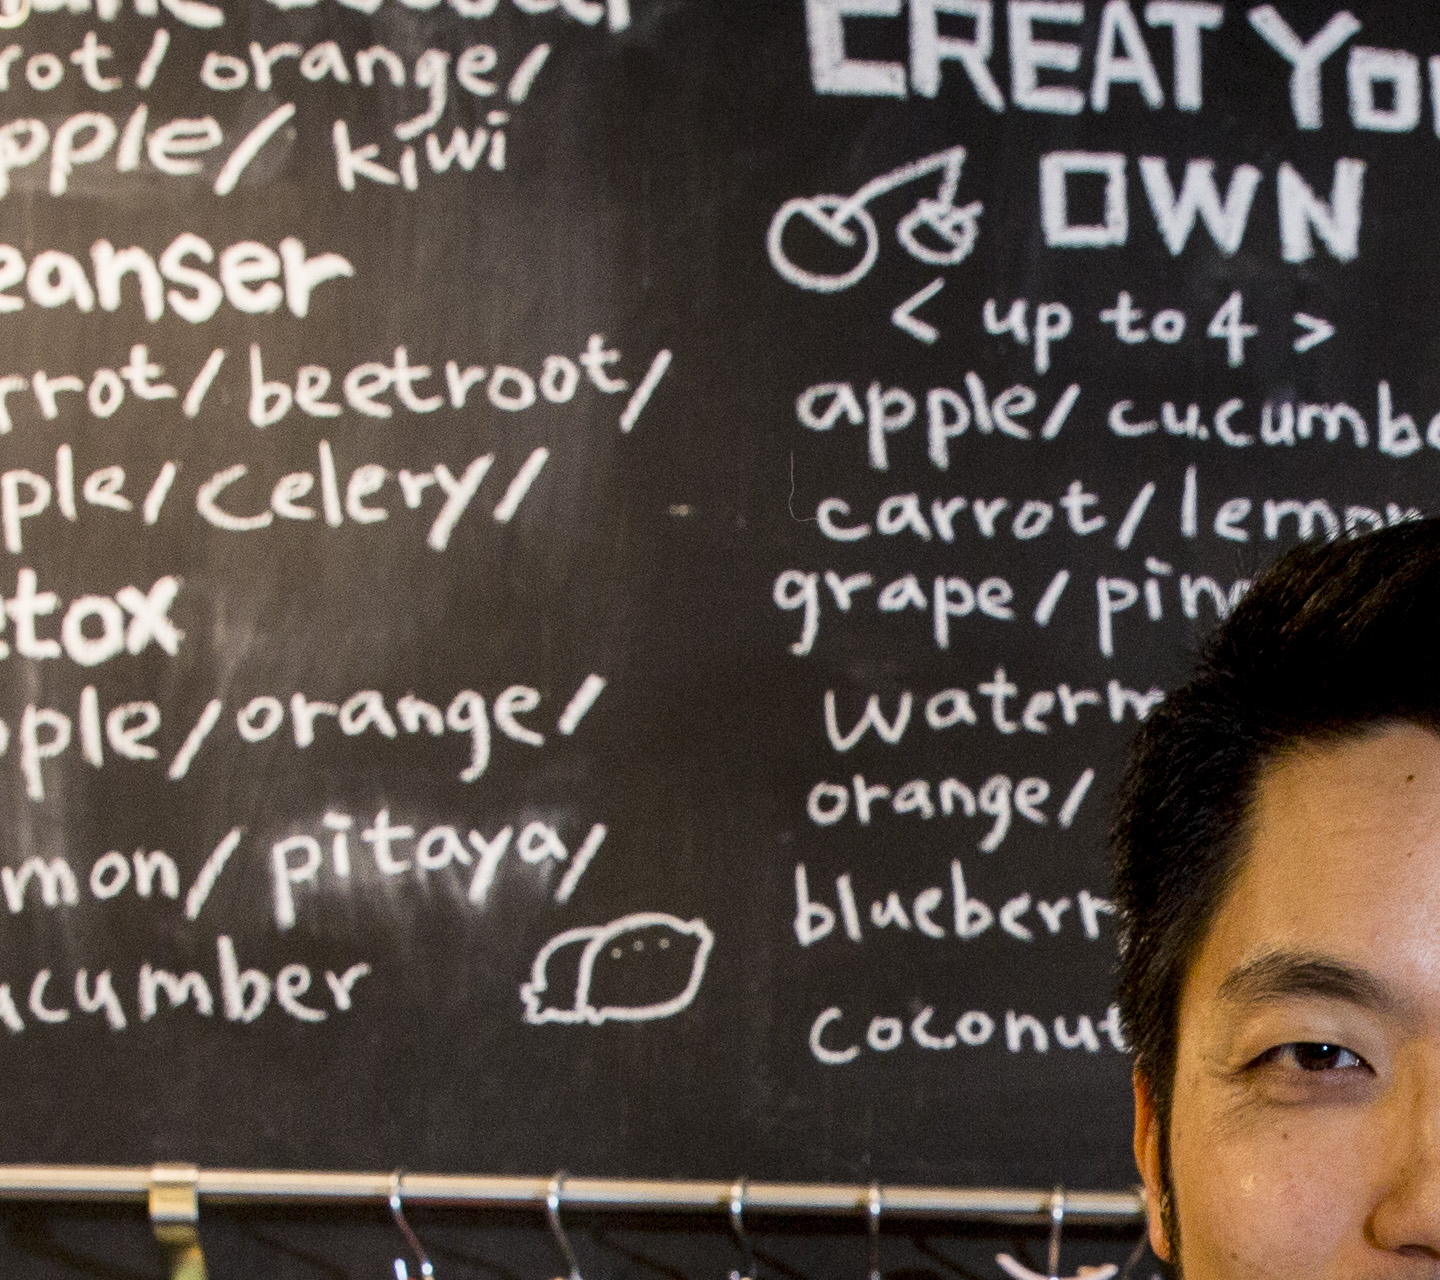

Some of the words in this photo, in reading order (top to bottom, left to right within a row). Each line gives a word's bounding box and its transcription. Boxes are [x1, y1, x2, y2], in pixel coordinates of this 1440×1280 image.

[804, 0, 1224, 116] CREAT
[331, 110, 508, 193] kiwi
[1039, 150, 1366, 264] OWN
[981, 298, 1074, 374] up
